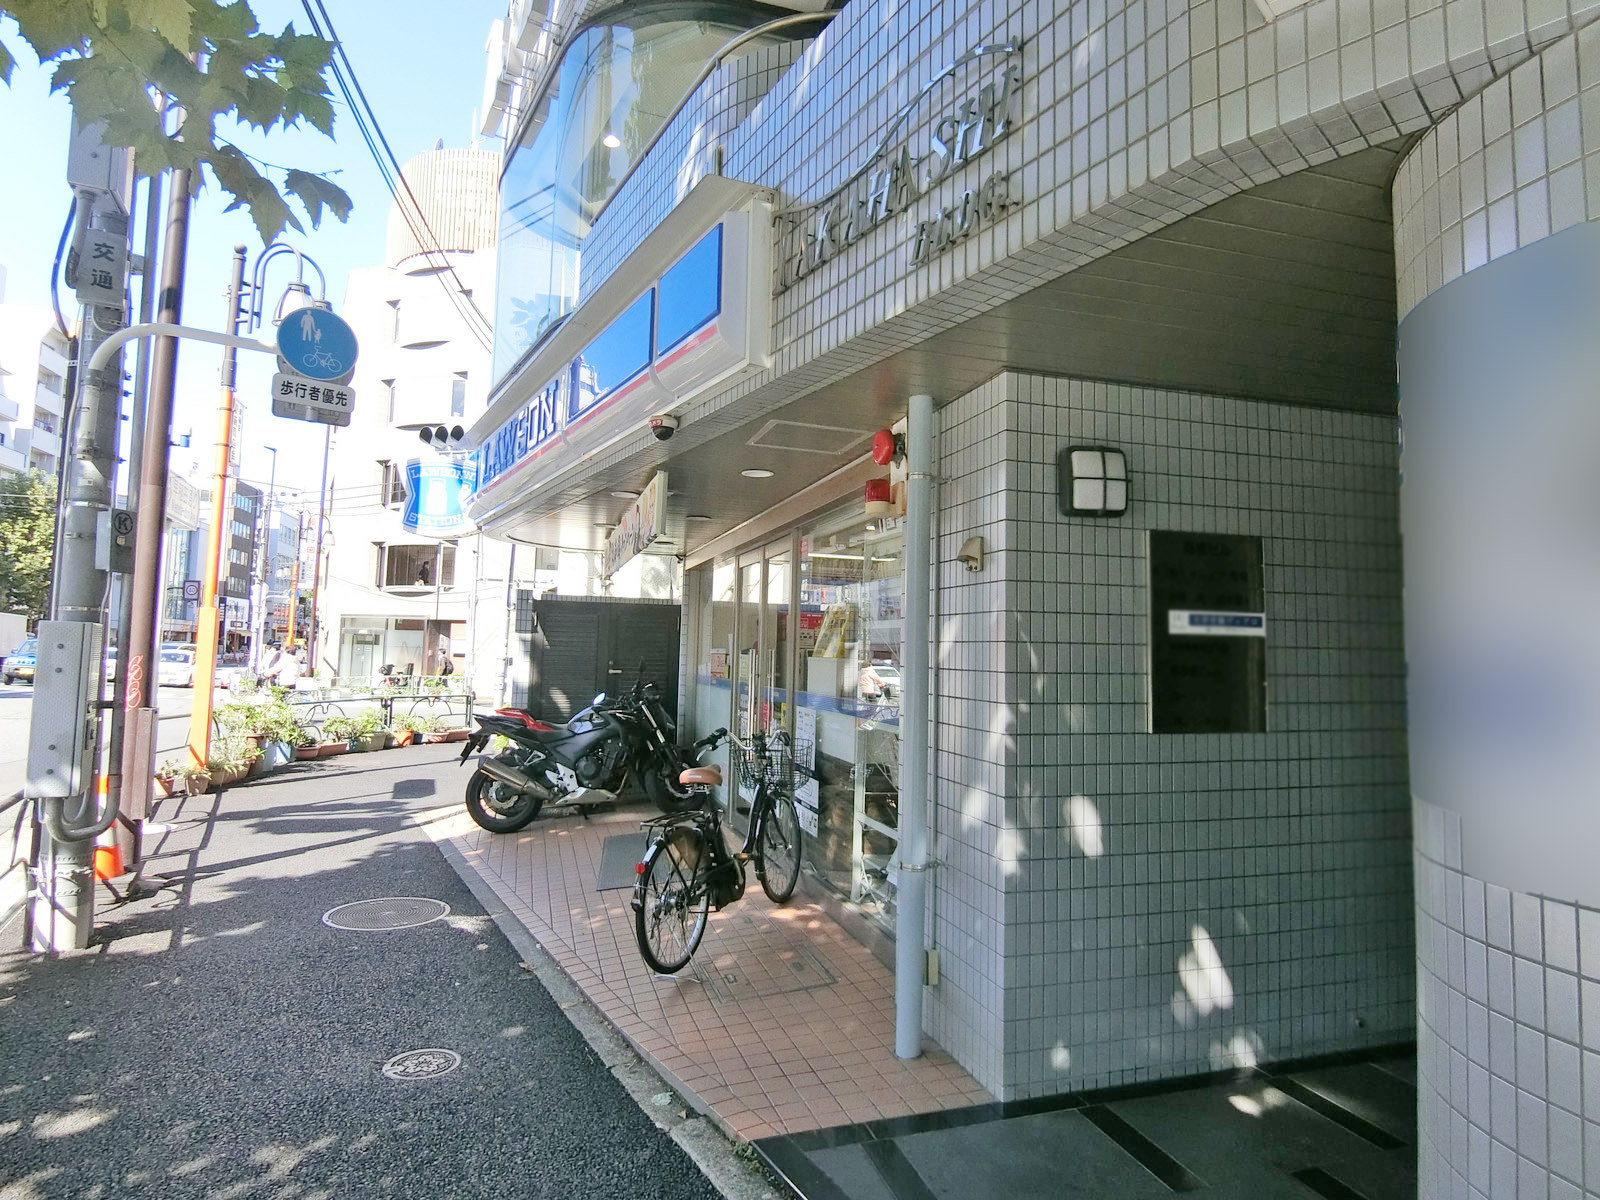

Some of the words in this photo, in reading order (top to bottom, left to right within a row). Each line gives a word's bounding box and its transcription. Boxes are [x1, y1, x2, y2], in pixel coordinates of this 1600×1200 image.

[772, 64, 1018, 296] TAKAHASHI
[91, 242, 115, 290] 交通
[280, 379, 348, 407] 歩行者優先
[482, 379, 559, 485] LAWSON
